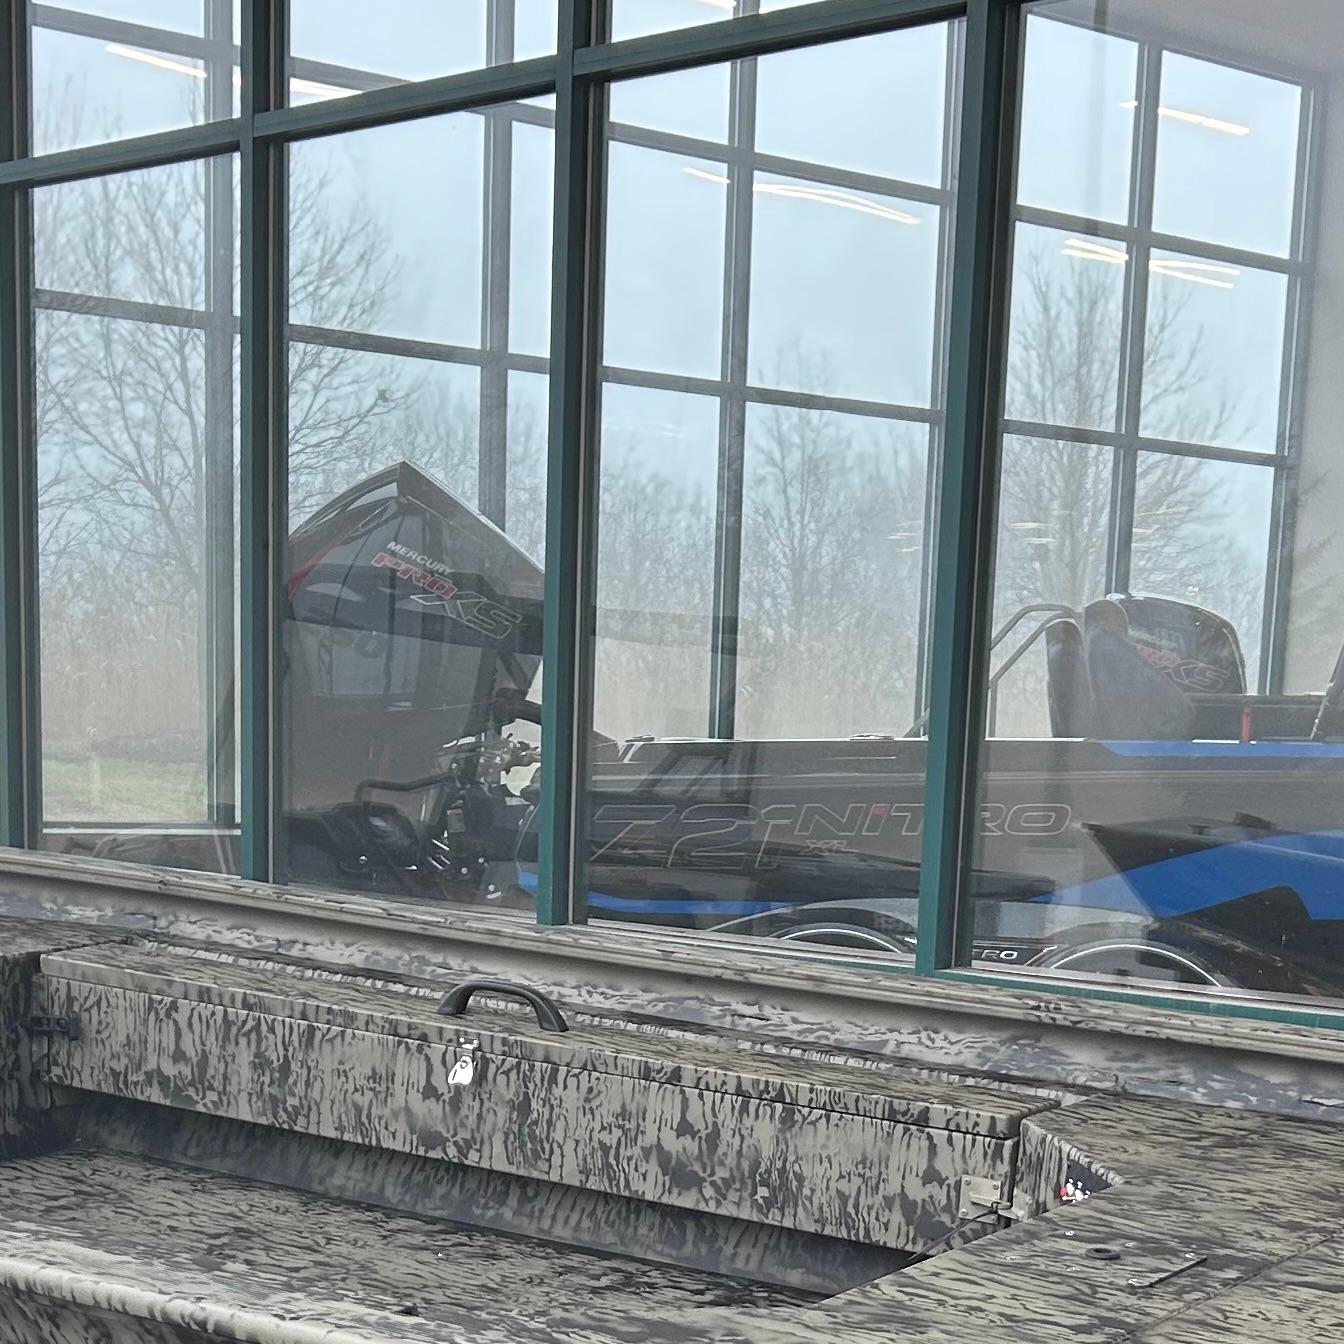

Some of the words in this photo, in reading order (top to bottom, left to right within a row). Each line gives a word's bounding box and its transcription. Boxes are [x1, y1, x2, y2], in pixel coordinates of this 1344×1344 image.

[371, 552, 458, 600] PRO
[387, 541, 454, 576] MERCURY
[410, 591, 523, 639] XS
